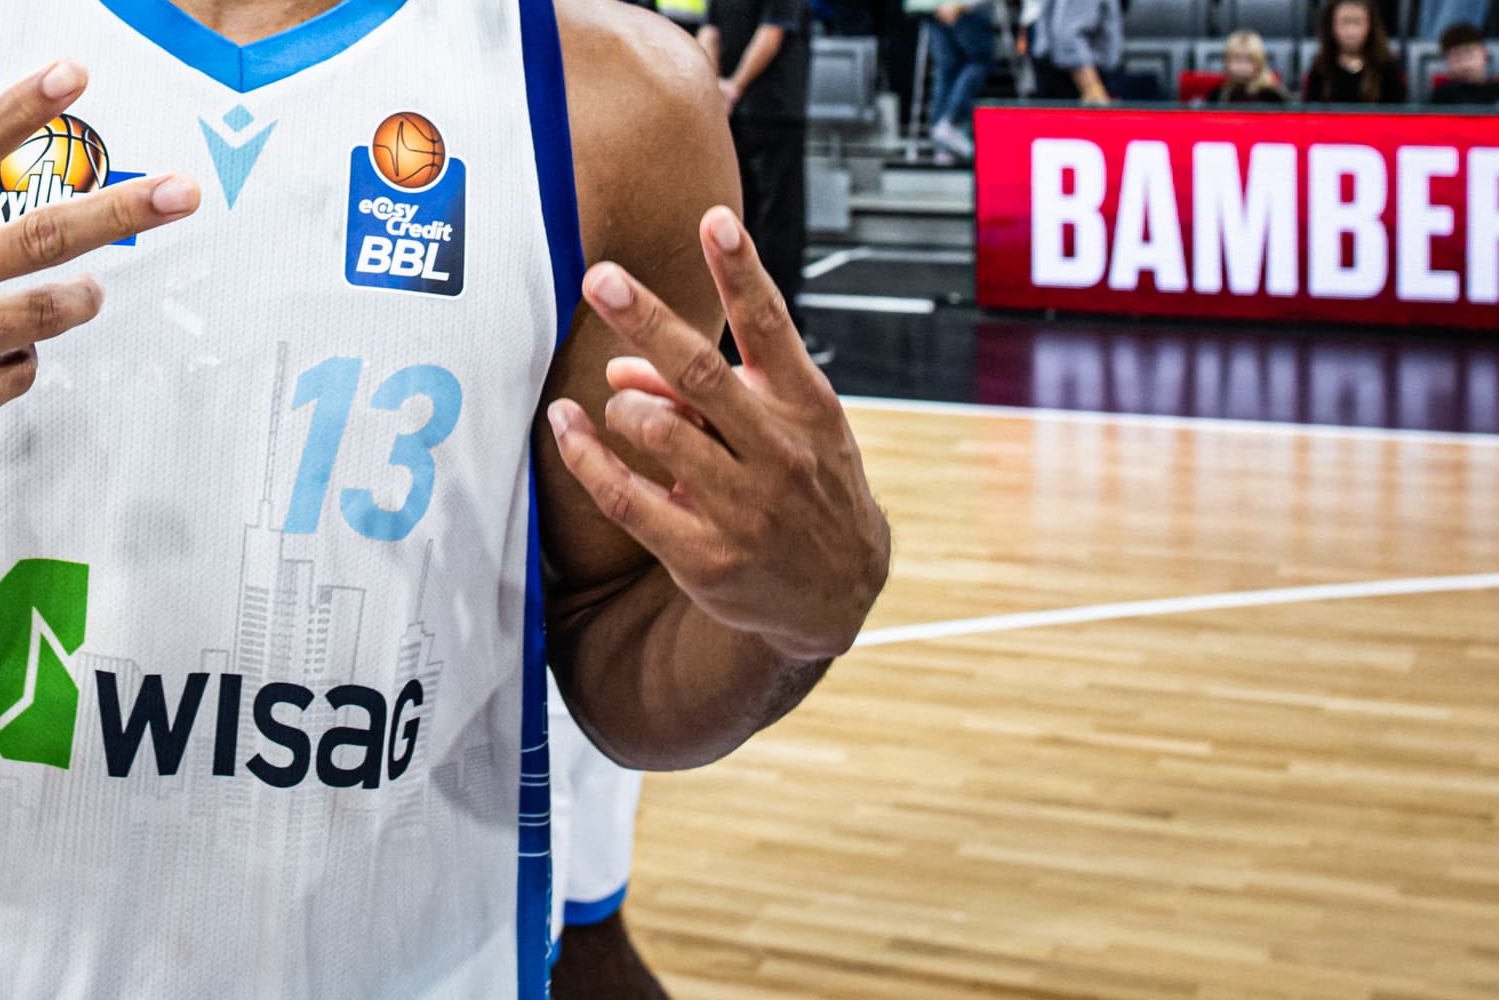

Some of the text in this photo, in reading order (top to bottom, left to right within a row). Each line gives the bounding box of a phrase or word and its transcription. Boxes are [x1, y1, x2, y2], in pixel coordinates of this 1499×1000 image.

[385, 216, 453, 242] Credit
[355, 235, 450, 281] BBL
[283, 355, 463, 542] 13
